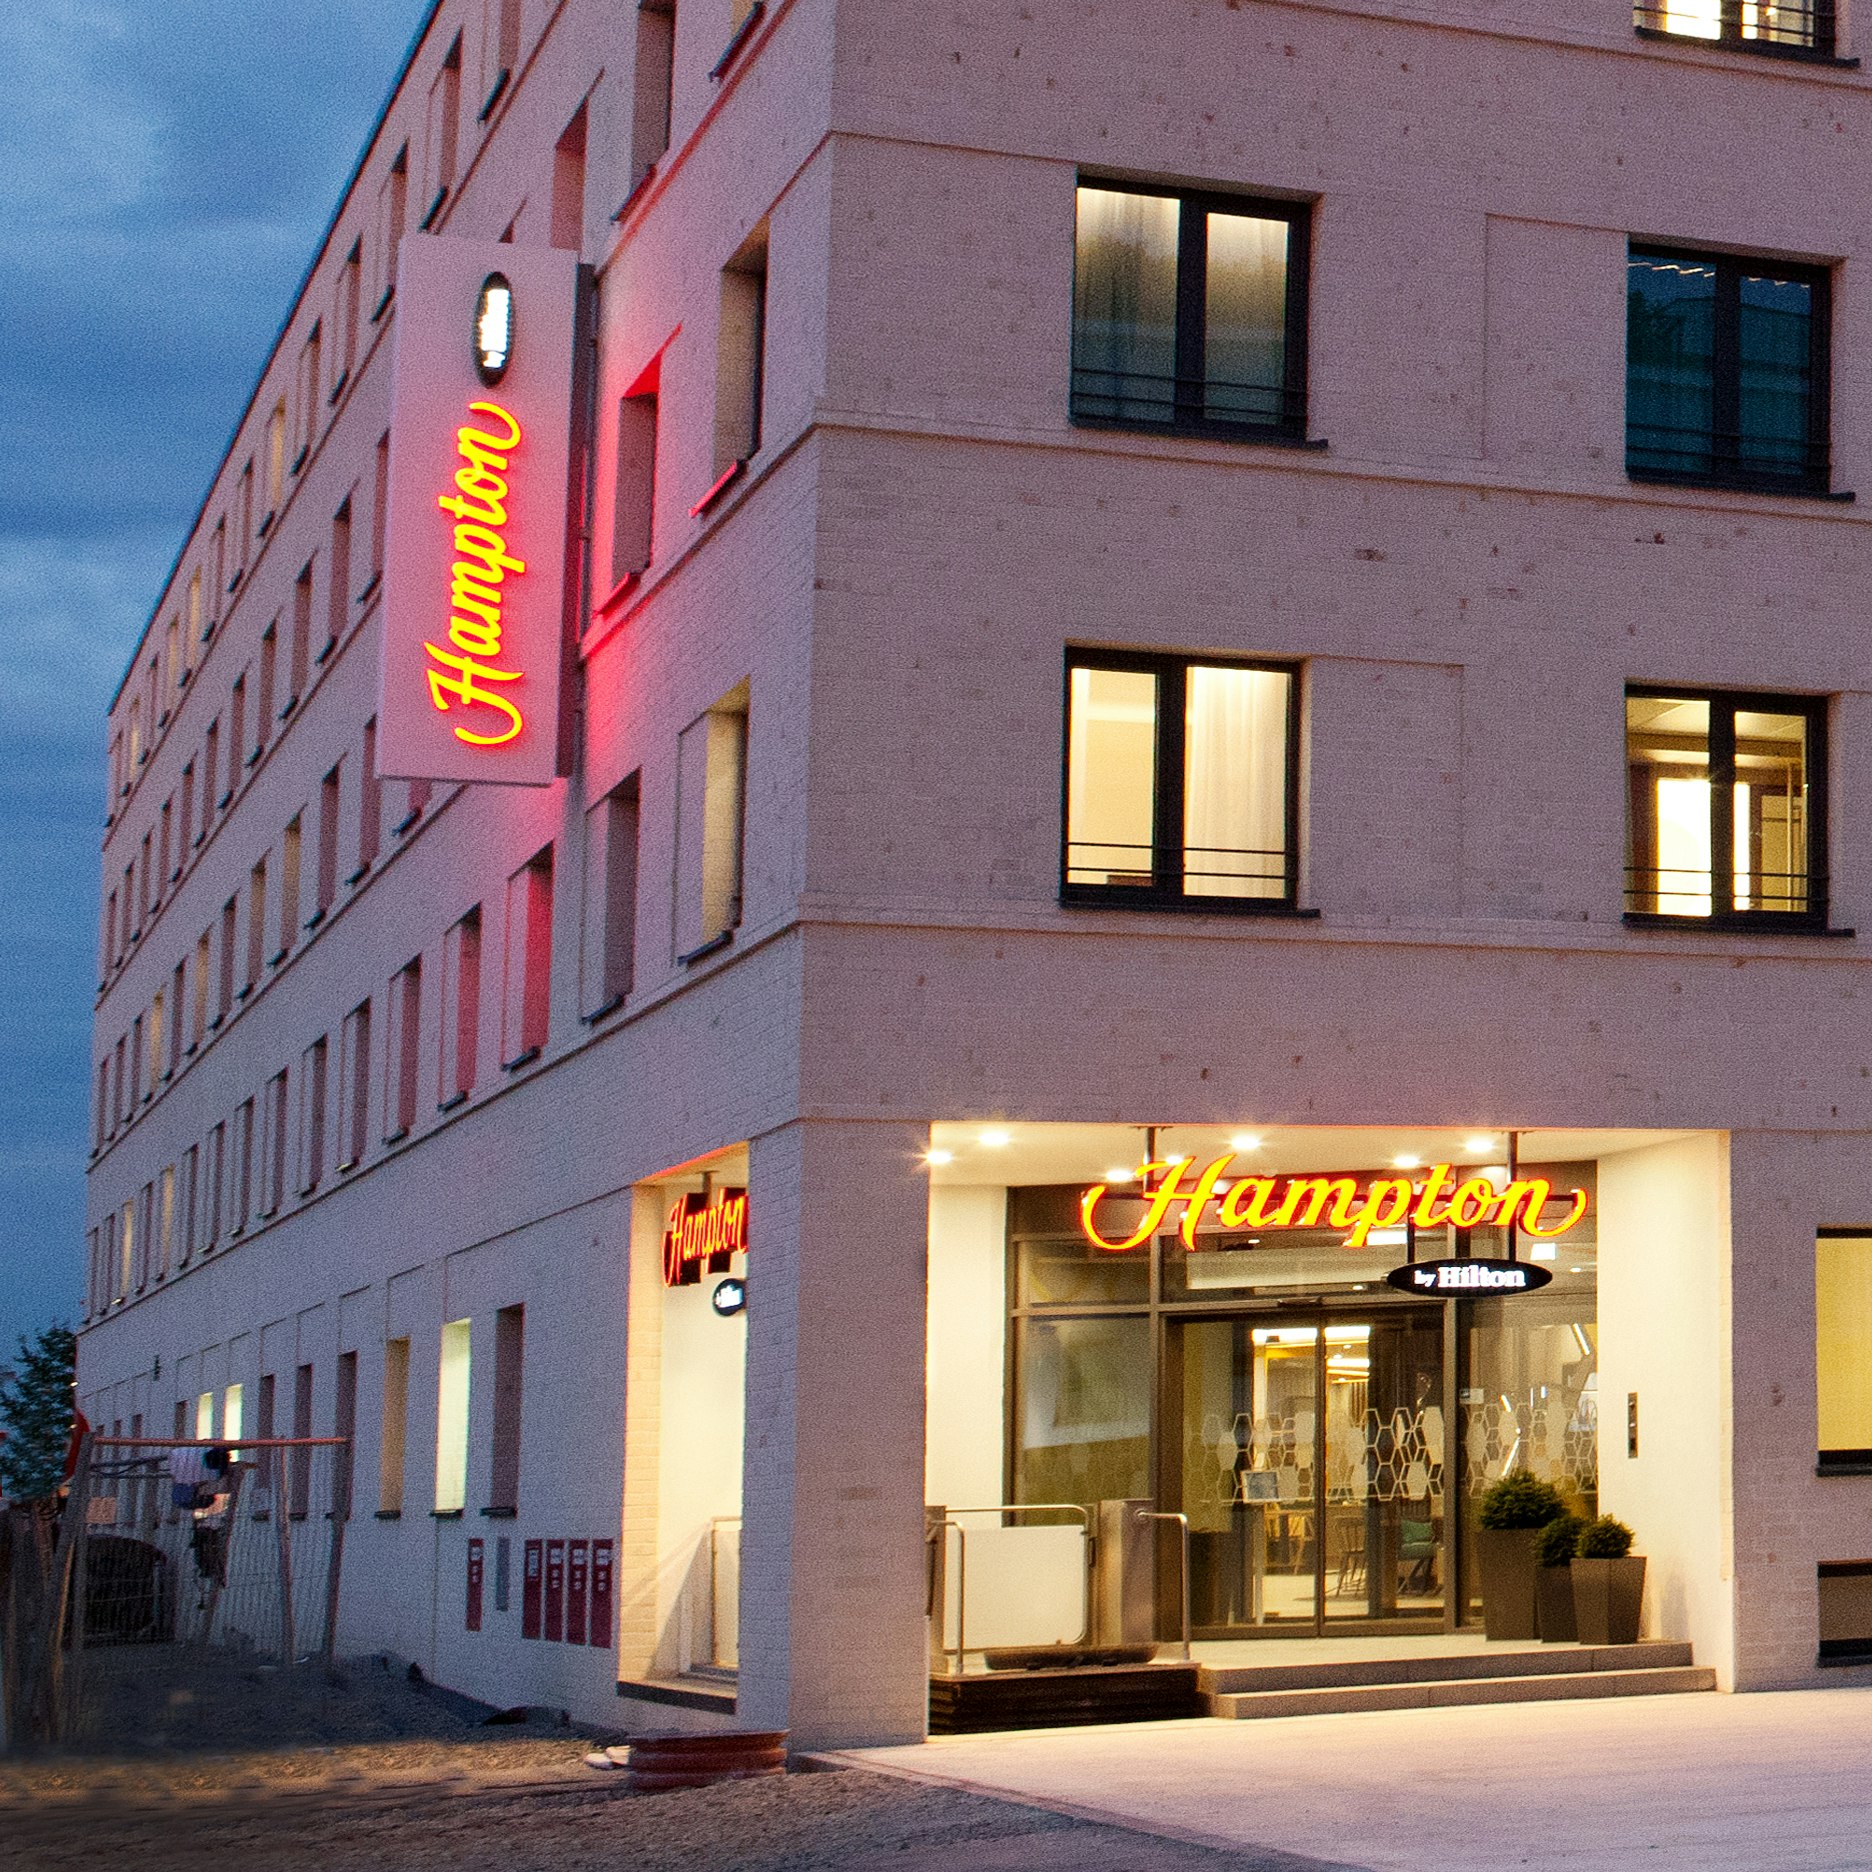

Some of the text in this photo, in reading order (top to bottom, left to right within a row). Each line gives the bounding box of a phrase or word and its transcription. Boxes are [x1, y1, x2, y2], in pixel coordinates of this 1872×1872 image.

[423, 400, 526, 746] Hampton
[1080, 1153, 1589, 1251] Hampton
[1413, 1264, 1527, 1288] by Hilton
